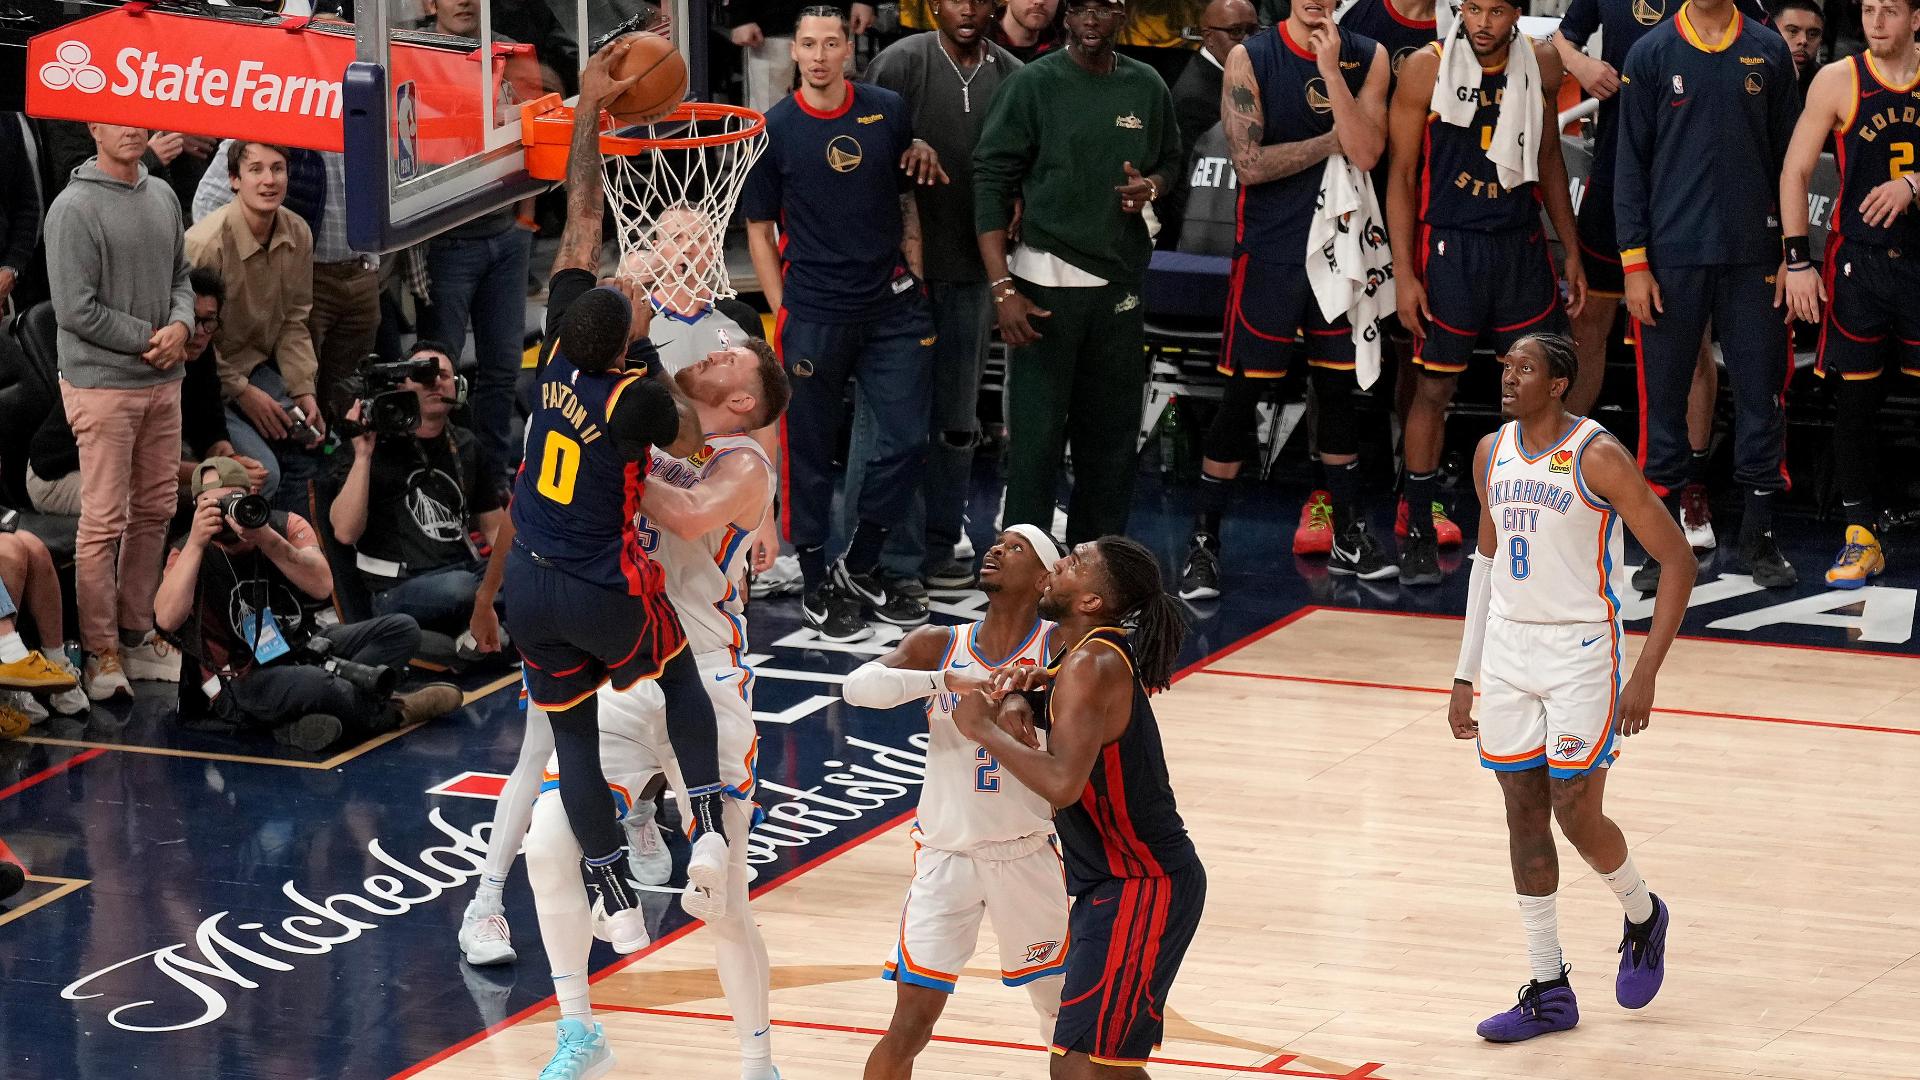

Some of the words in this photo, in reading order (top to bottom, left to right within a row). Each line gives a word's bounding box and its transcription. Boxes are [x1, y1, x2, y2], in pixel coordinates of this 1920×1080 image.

[1740, 57, 1765, 65] Rakuten
[1191, 157, 1227, 188] GET
[1889, 142, 1915, 180] 2
[1455, 171, 1512, 198] STA
[580, 423, 602, 444] II
[537, 430, 581, 505] 0
[1551, 463, 1571, 472] Love's
[1503, 507, 1540, 532] CITY
[1508, 535, 1531, 580] 8
[975, 746, 1000, 793] 2
